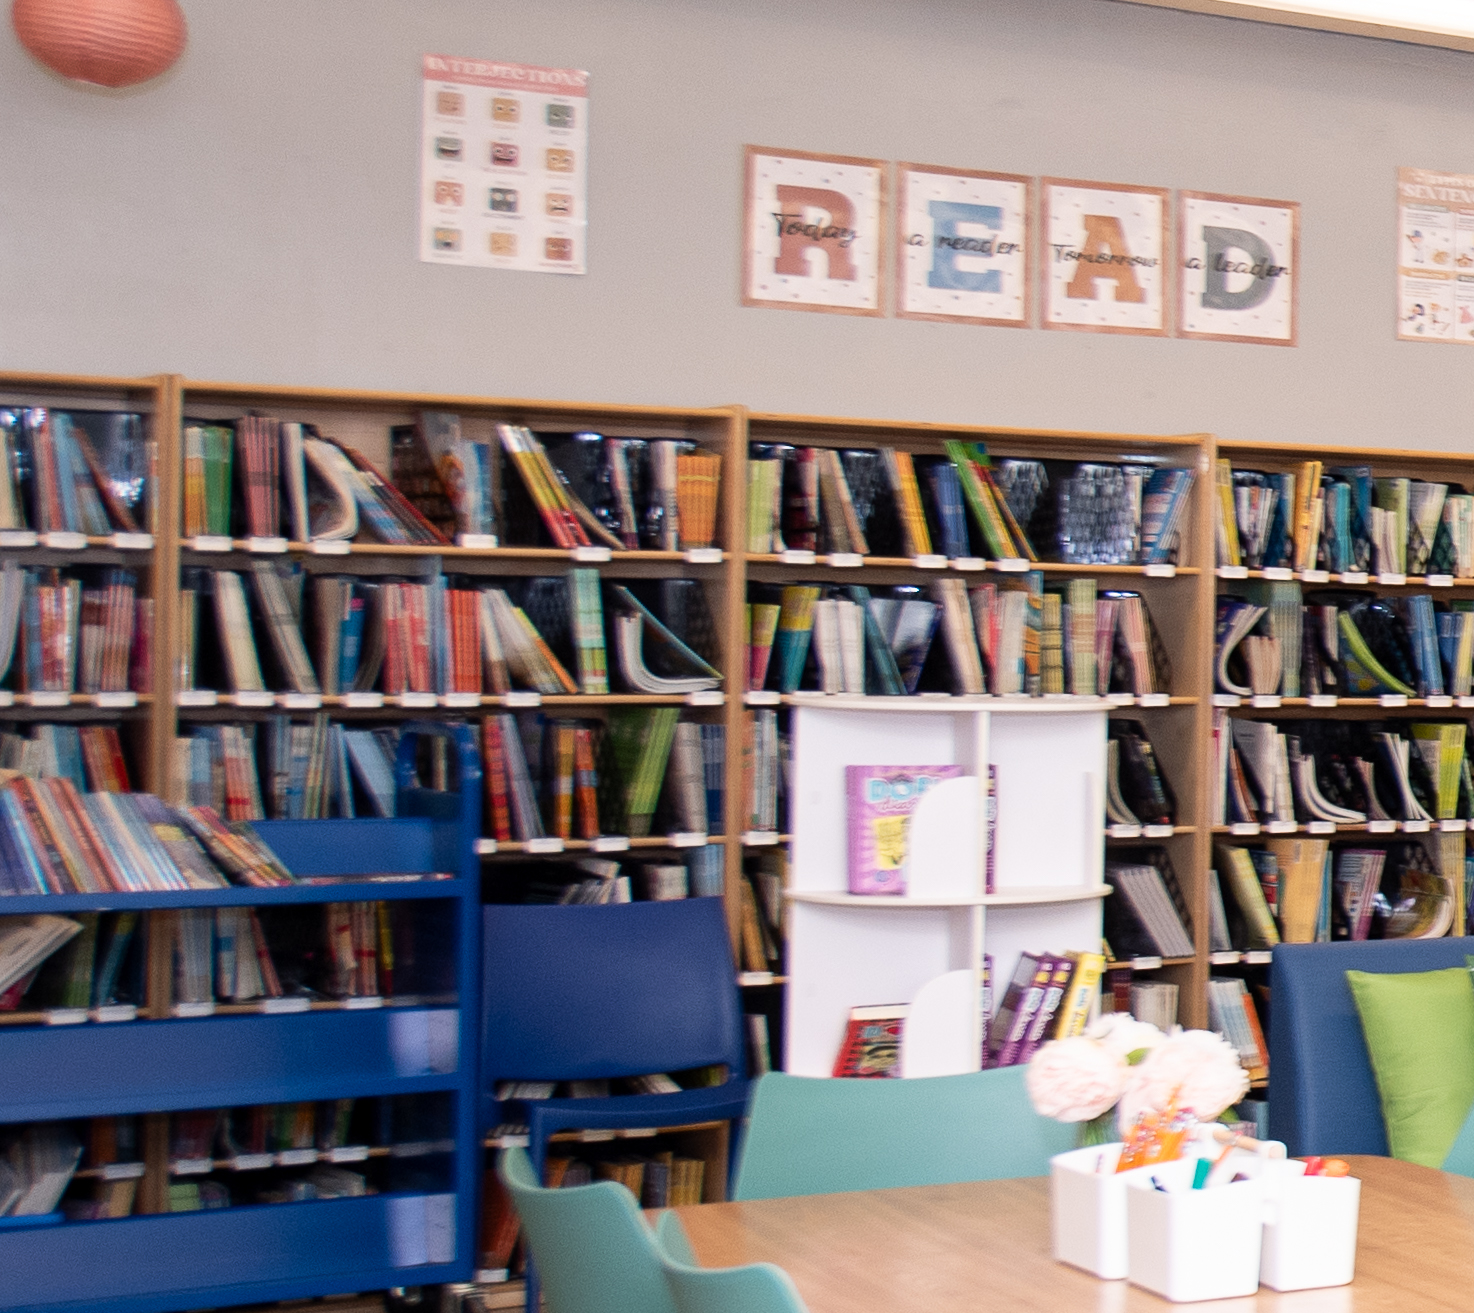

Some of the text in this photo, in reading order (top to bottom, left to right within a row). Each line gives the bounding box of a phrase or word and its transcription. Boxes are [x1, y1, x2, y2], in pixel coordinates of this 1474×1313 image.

[771, 212, 858, 248] Today
[906, 233, 1024, 257] a reader
[1050, 243, 1160, 268] Tomorrow
[1214, 252, 1288, 280] leader
